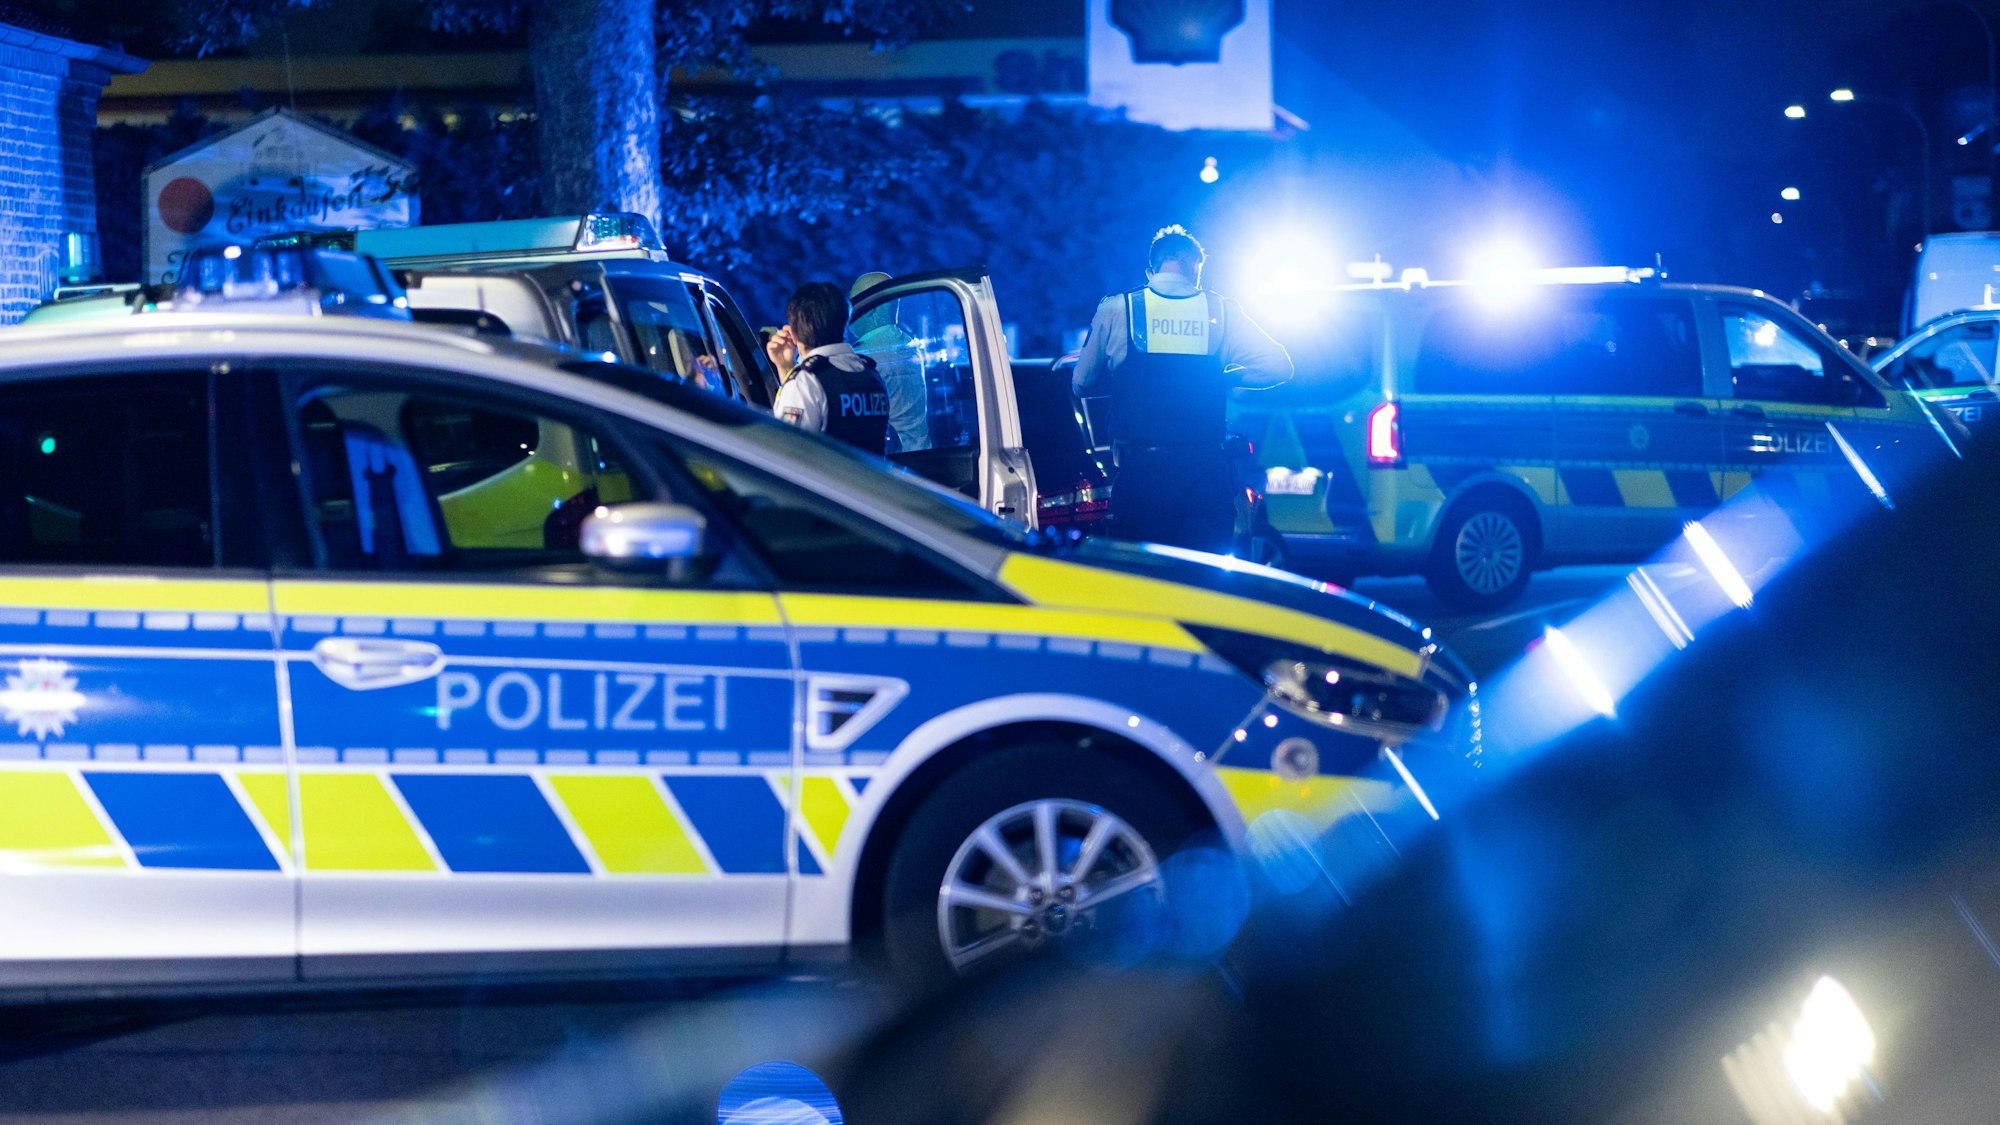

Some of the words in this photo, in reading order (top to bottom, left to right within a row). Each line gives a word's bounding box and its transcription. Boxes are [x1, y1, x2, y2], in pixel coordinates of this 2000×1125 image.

[1151, 318, 1204, 337] POLIZEI
[840, 393, 889, 417] POLIZE
[436, 671, 728, 731] POLIZEI
